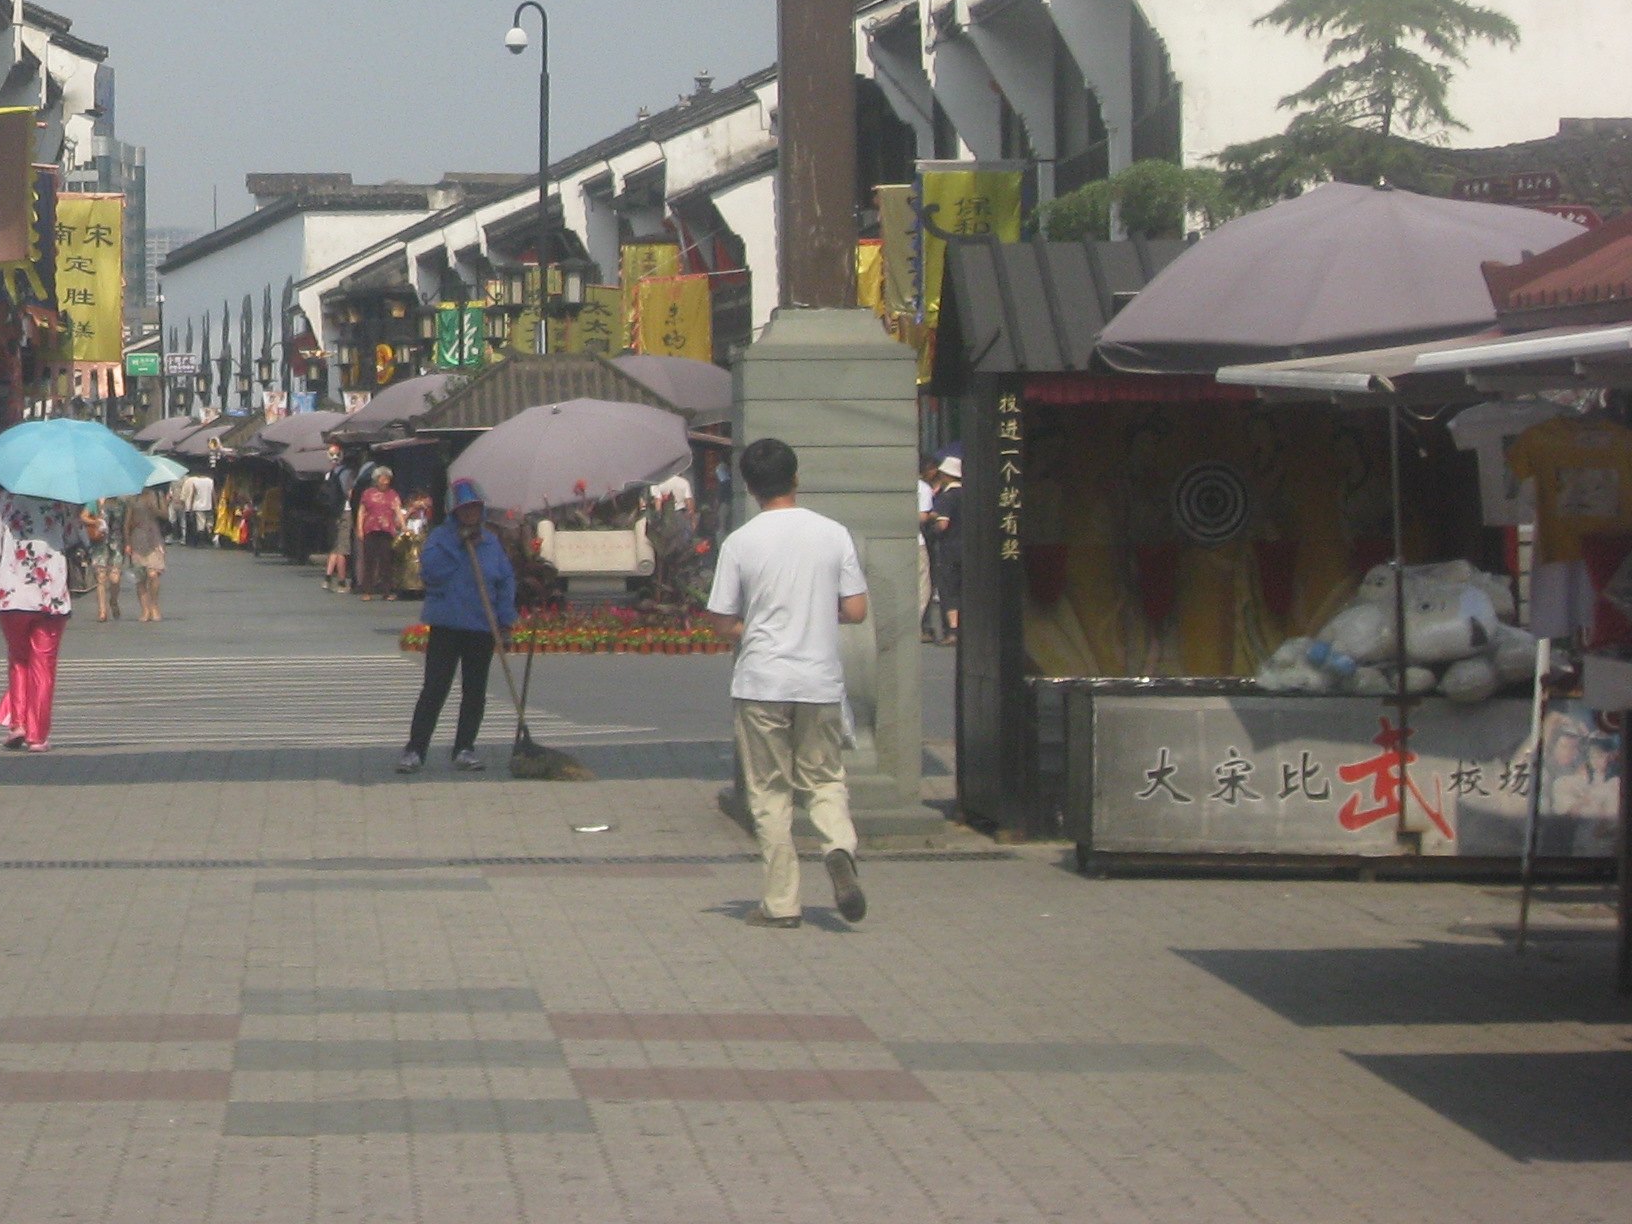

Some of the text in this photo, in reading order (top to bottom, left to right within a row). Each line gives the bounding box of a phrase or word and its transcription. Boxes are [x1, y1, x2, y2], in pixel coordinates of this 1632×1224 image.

[998, 393, 1023, 561] 投进一个就有奖
[1137, 716, 1537, 841] 大宋比武校场
